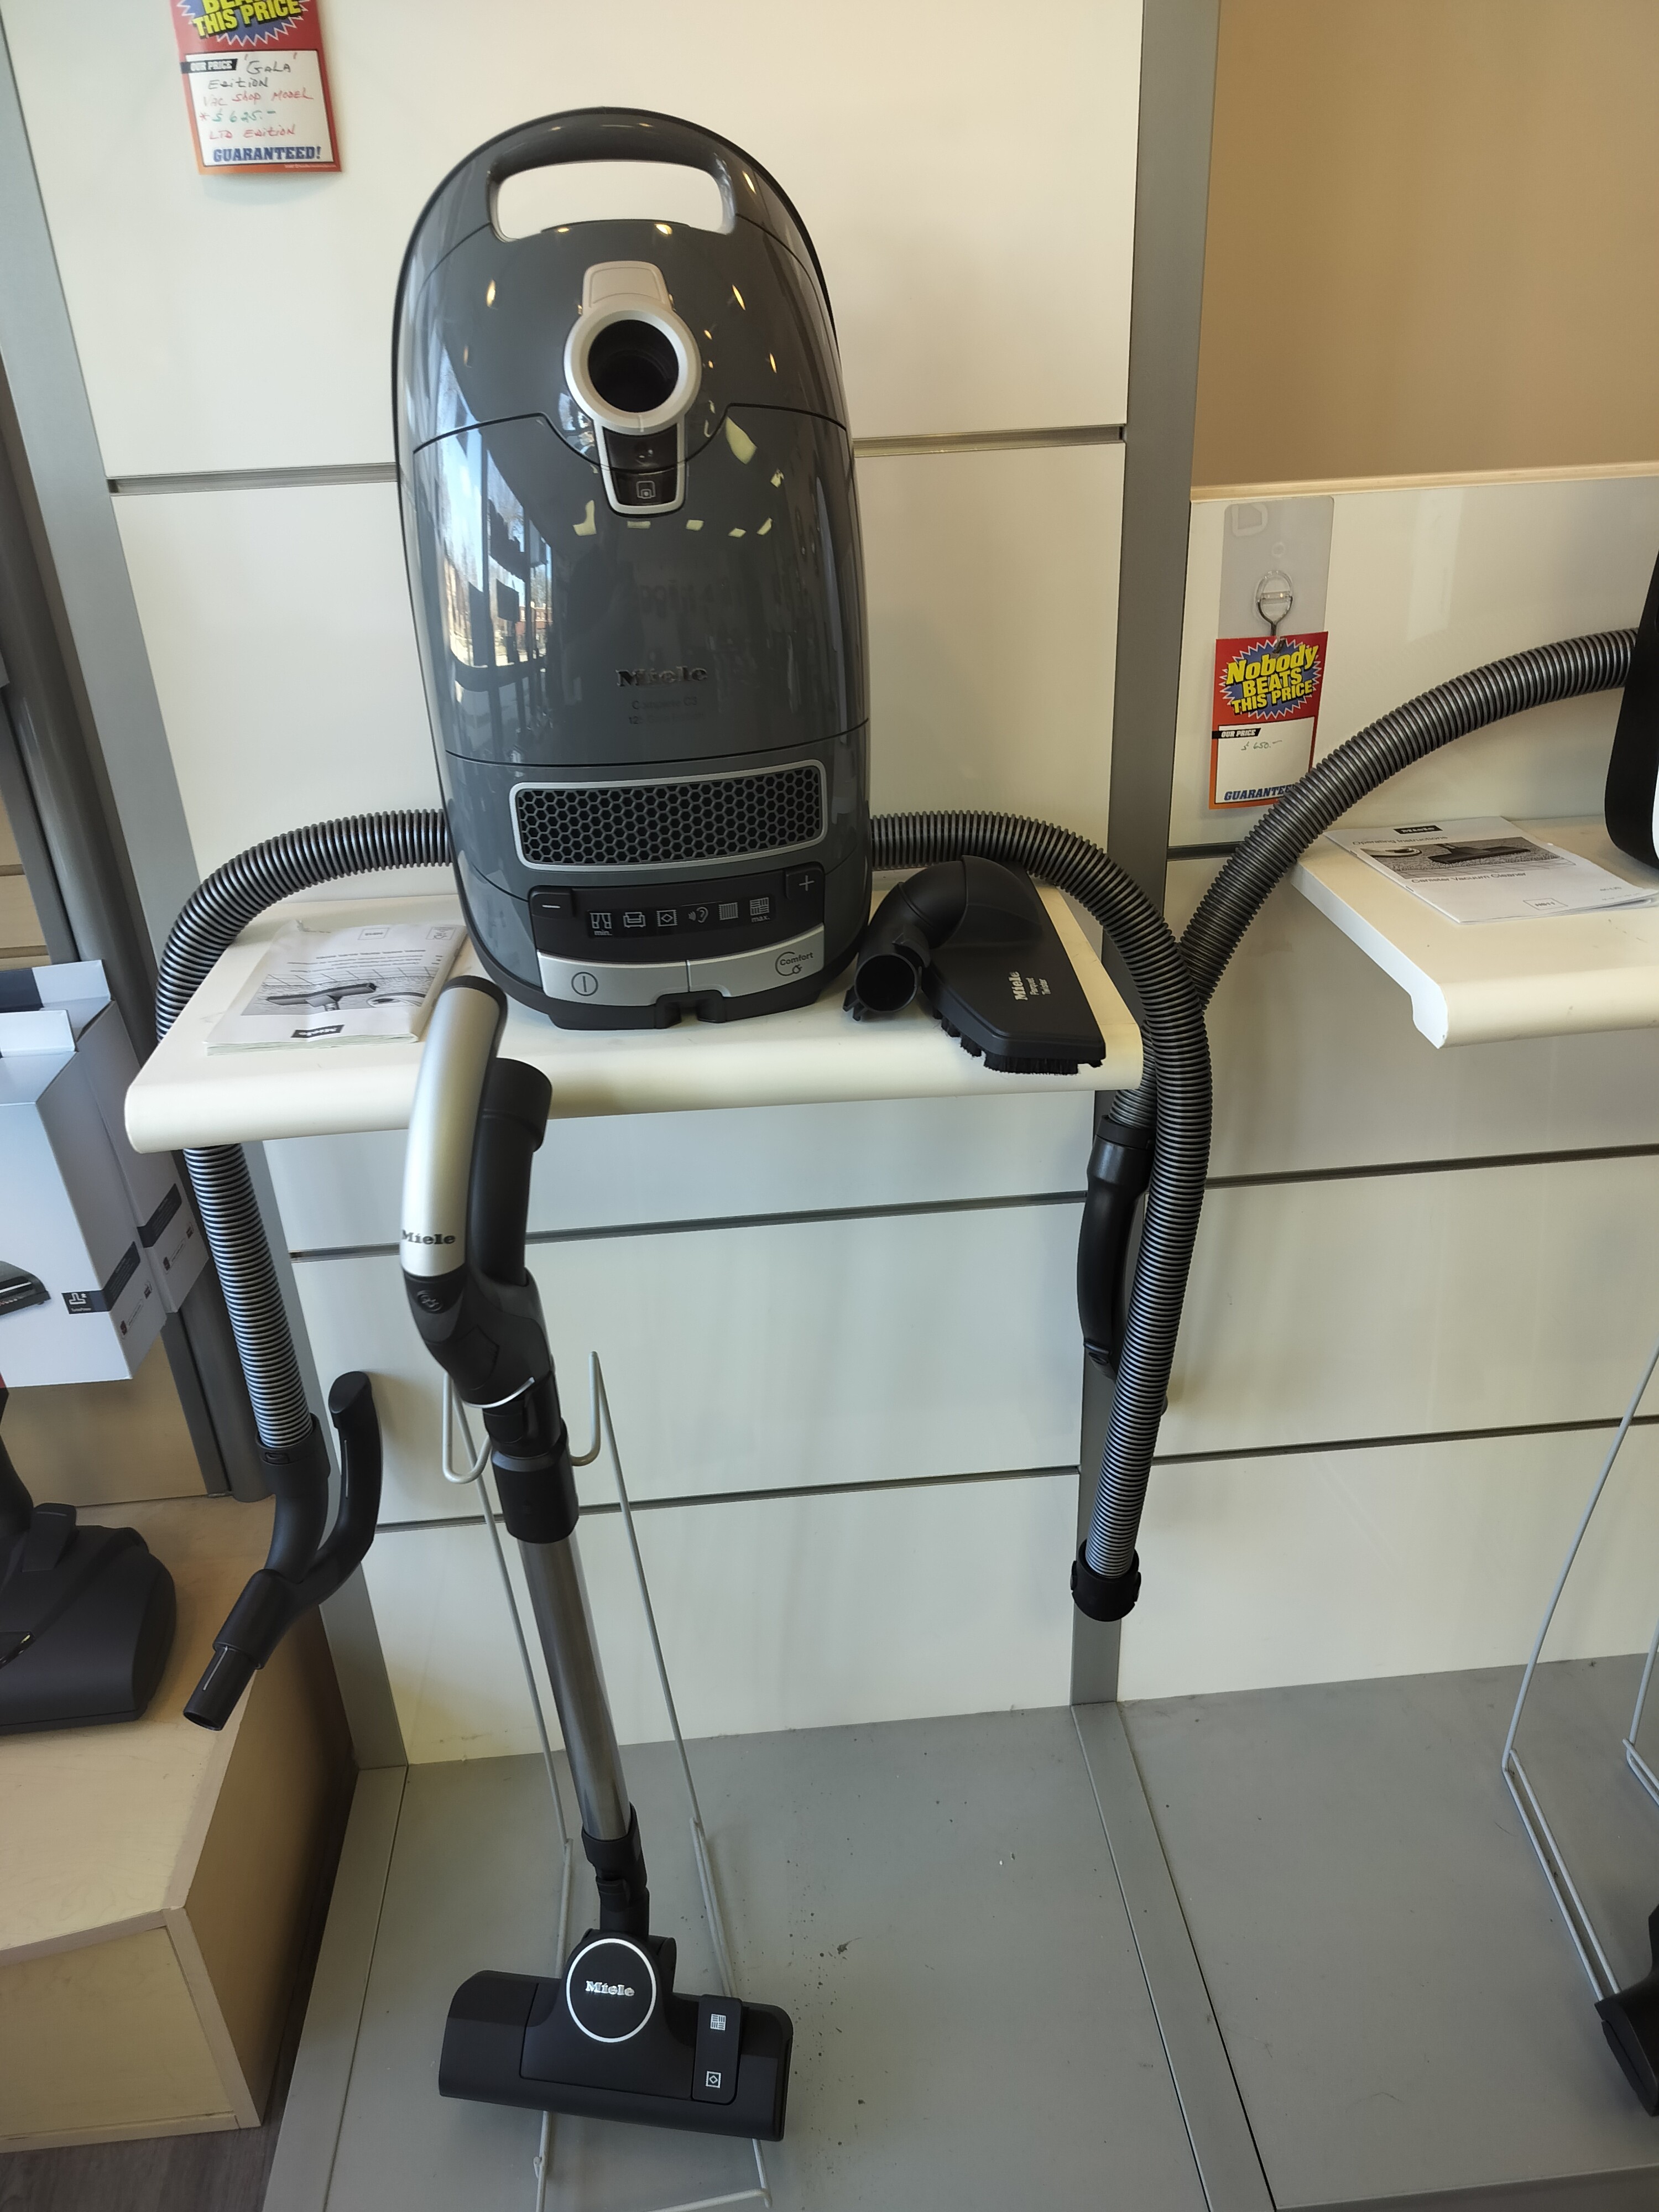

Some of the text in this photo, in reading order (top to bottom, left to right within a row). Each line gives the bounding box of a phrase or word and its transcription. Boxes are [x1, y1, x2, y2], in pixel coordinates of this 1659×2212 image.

[192, 9, 237, 36] THIS
[241, 0, 301, 24] PRICE
[190, 61, 232, 71] OUR PRICE
[213, 146, 321, 162] GUARANTEED!
[1226, 644, 1318, 685] Nobody
[615, 665, 708, 687] Miele
[1243, 667, 1302, 698] BEATS
[1232, 679, 1313, 713] THIS PRICE
[1397, 836, 1448, 844] Instructions
[780, 952, 814, 966] Comfort
[1008, 971, 1028, 1000] Miele
[1025, 977, 1040, 995] Parquet
[1039, 978, 1051, 995] Twister
[402, 1228, 456, 1245] Miele
[585, 1980, 635, 1997] Miele
